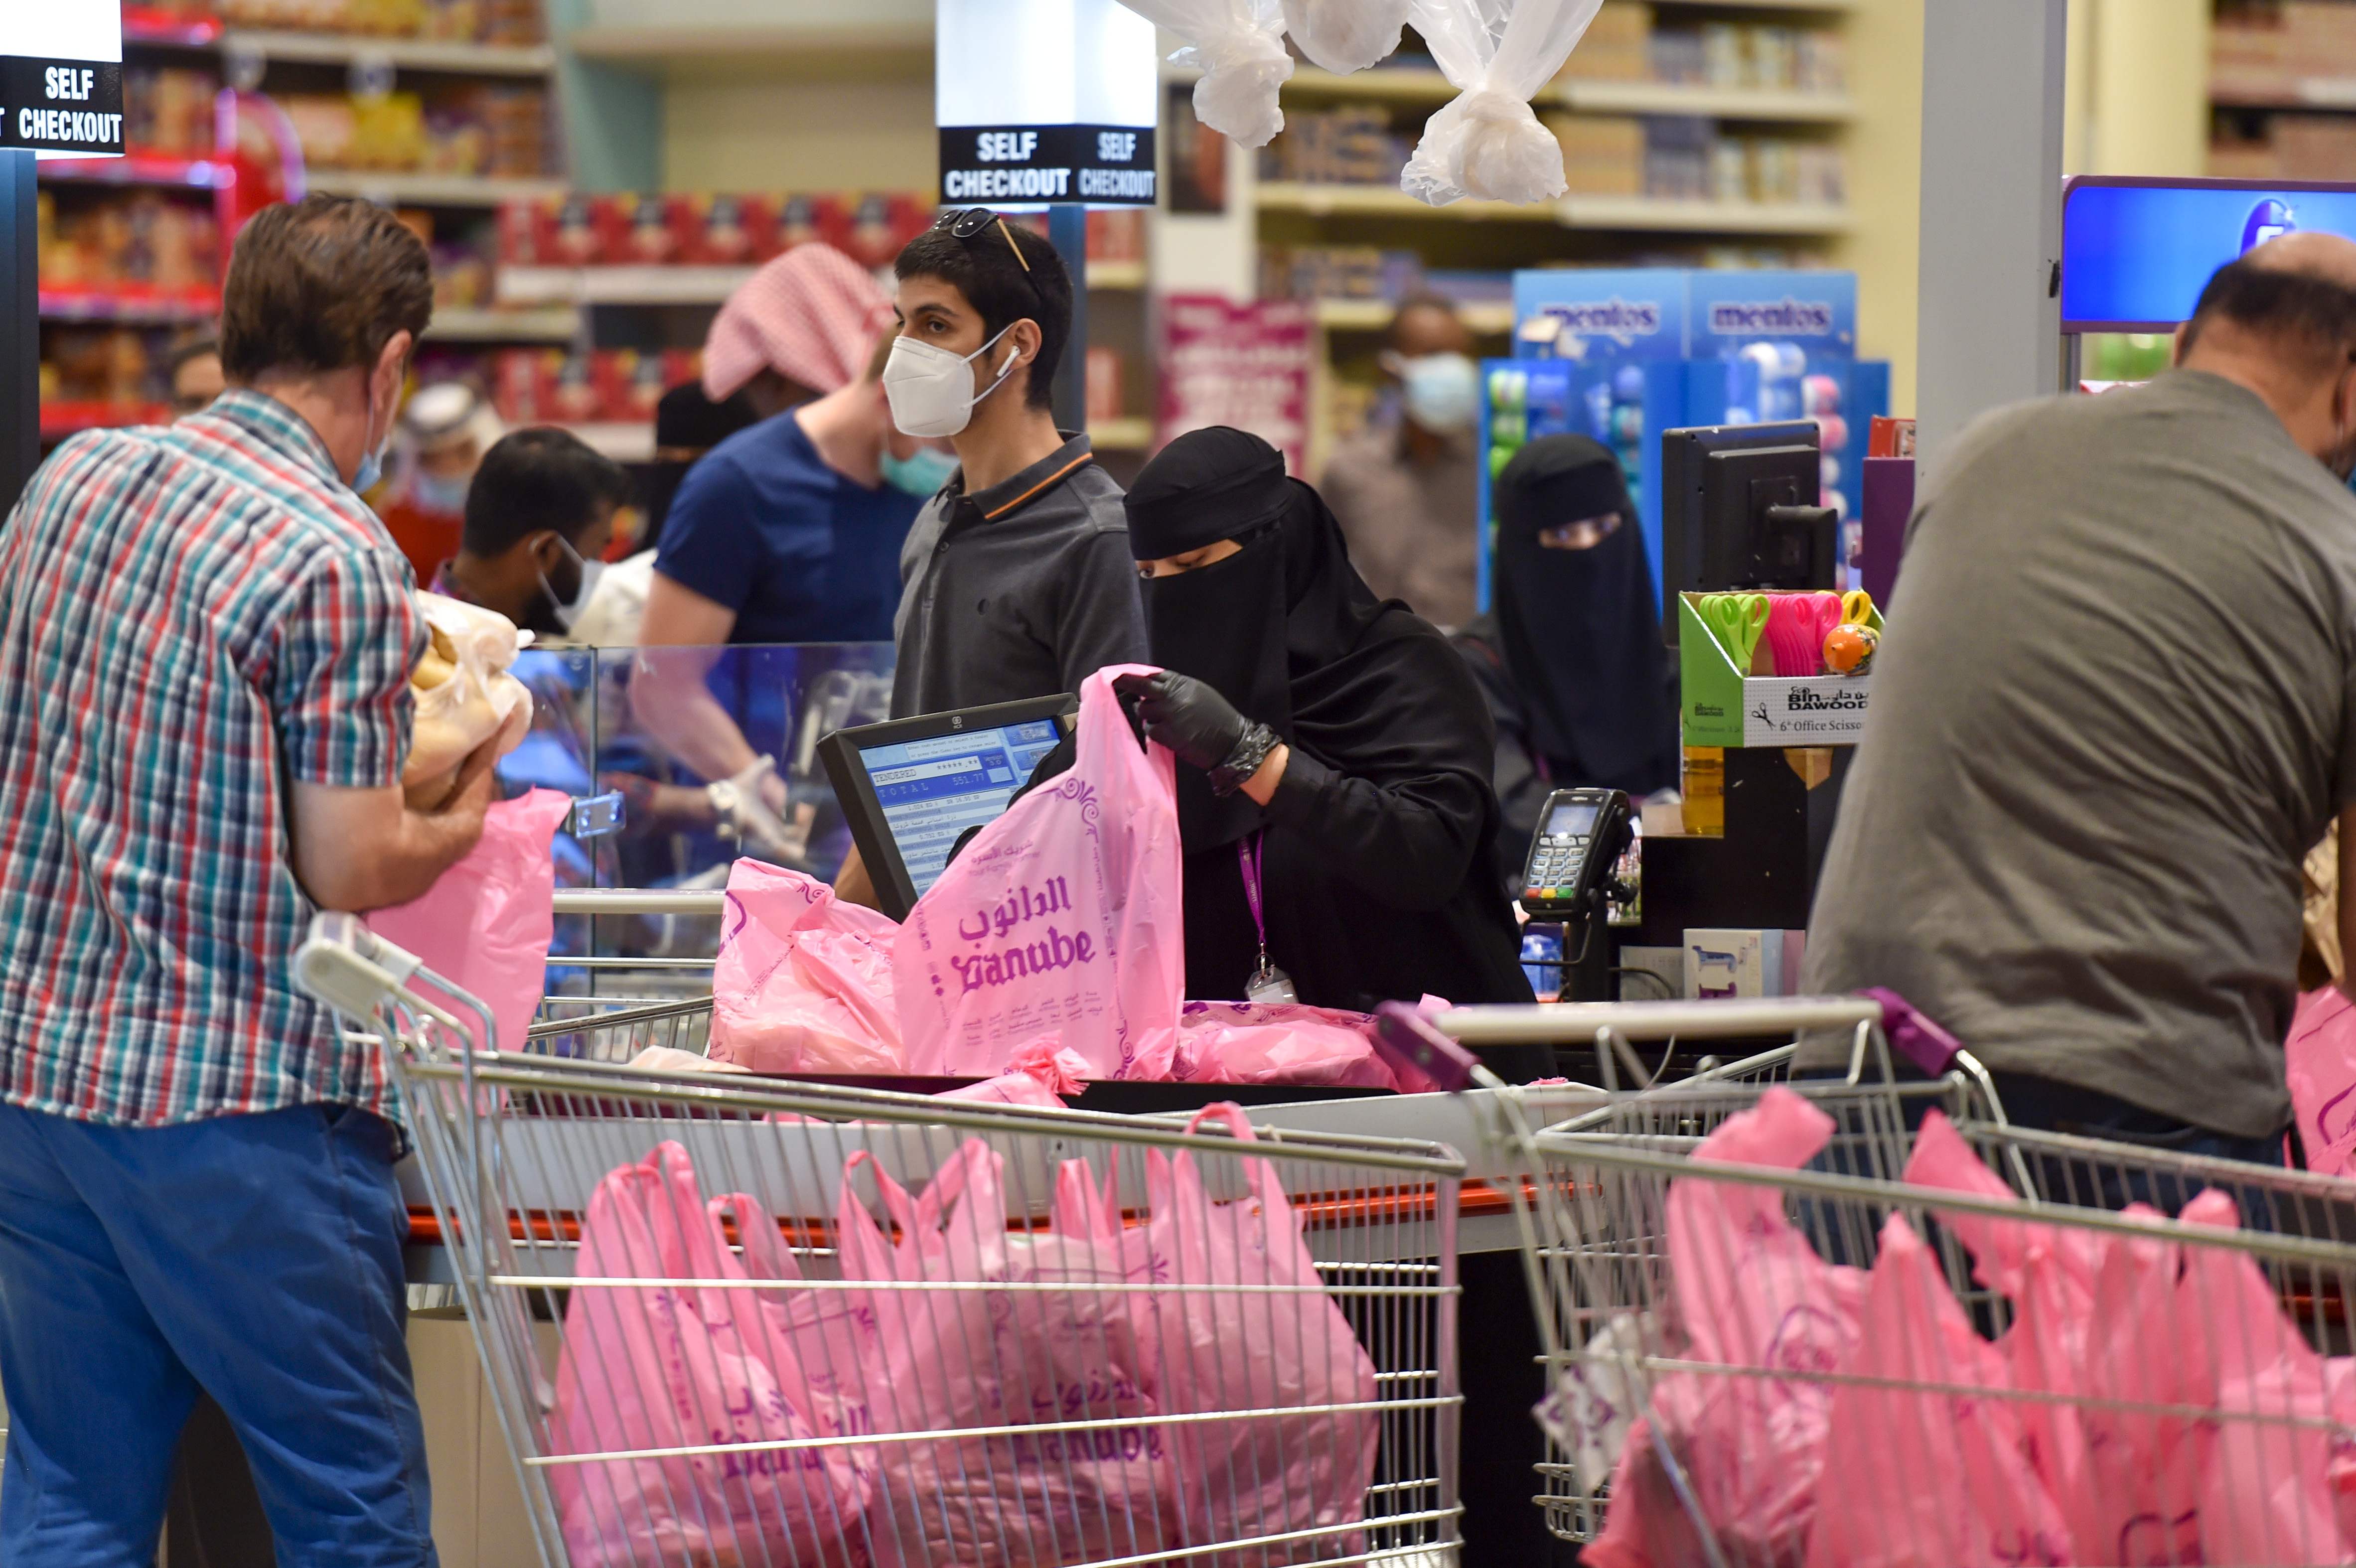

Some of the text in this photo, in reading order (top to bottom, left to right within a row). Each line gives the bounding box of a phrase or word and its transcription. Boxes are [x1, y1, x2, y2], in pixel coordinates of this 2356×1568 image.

[45, 66, 94, 100] SELF
[19, 108, 122, 143] CHECKOUT
[977, 132, 1037, 161] SELF
[1097, 132, 1136, 161] SELF
[945, 168, 1071, 197] CHECKOUT
[1078, 169, 1156, 198] CHECKOUT
[1543, 303, 1654, 326] mentos
[1715, 302, 1828, 326] mentos
[1794, 720, 1826, 731] Office
[1829, 720, 1862, 730] Scisso
[874, 769, 917, 783] TENDERED
[953, 773, 984, 786] 551.77
[959, 875, 1072, 950] الدانوب
[951, 925, 1096, 998] Danube
